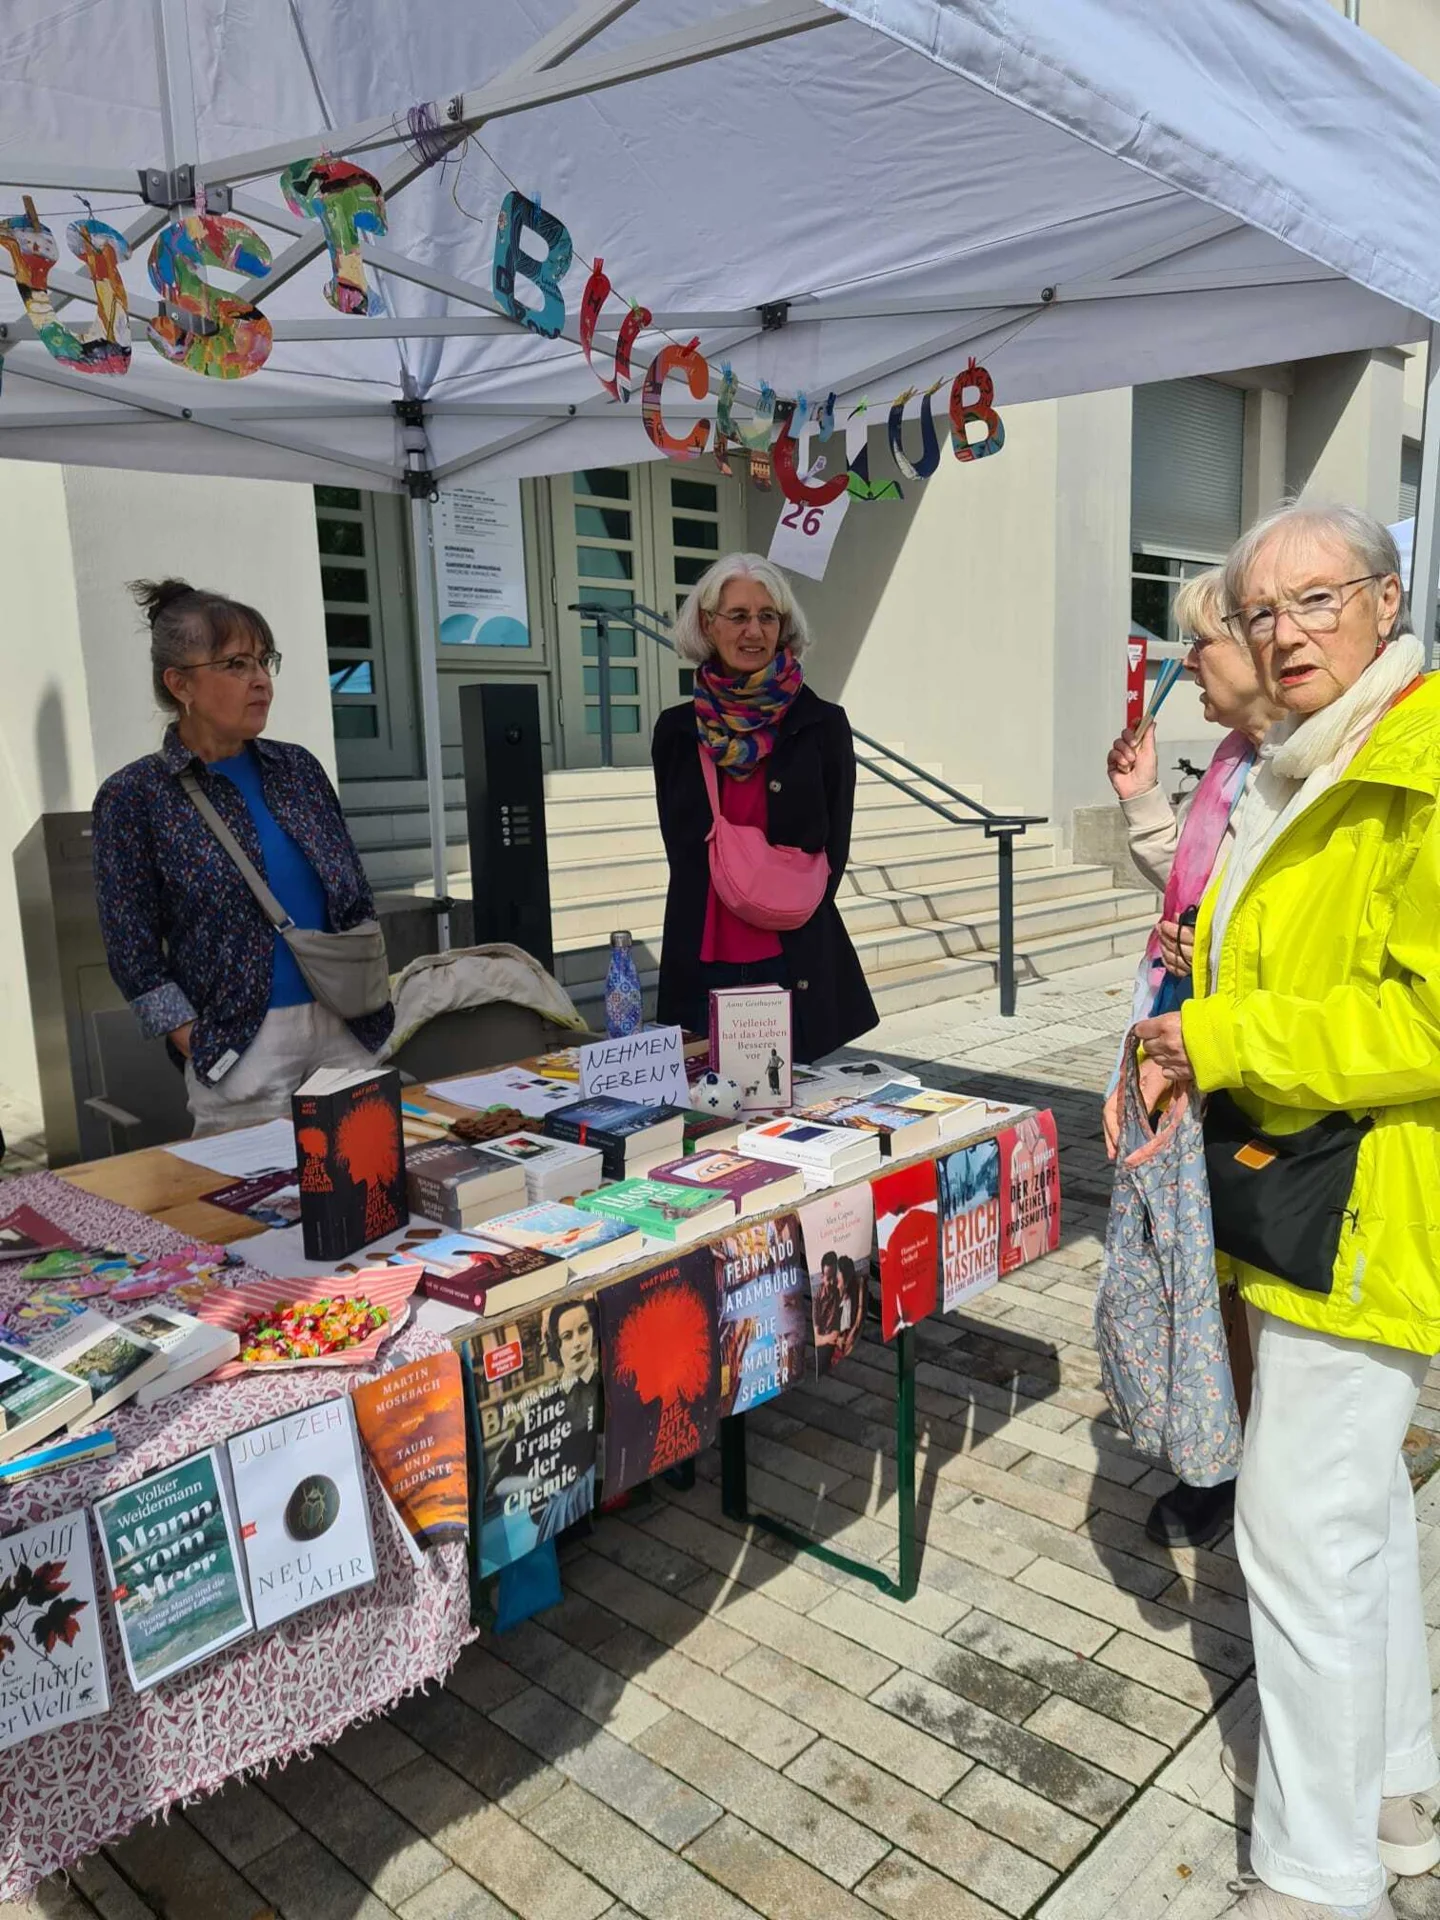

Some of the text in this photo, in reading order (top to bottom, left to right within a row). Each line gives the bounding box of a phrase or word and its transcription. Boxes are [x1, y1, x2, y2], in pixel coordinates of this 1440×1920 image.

[781, 500, 824, 536] 26
[722, 1029, 787, 1040] hat das Leben
[732, 1018, 777, 1028] Vielleicht
[586, 1033, 677, 1071] NEHMEN
[738, 1042, 777, 1050] Besseres
[590, 1064, 665, 1095] GEBEN
[302, 1173, 331, 1187] ZORA
[1010, 1166, 1056, 1202] DER ZOPF
[366, 1203, 396, 1228] ZORA
[1018, 1191, 1047, 1214] MEINER
[944, 1197, 997, 1259] ERICH
[726, 1239, 794, 1283] FERNANDO
[725, 1267, 798, 1314] ARAMBURU
[755, 1316, 777, 1341] DIE
[744, 1341, 789, 1374] MAUER
[375, 1378, 441, 1414] MOSEBACH
[382, 1367, 429, 1395] MARTIN
[741, 1367, 790, 1403] SEGLER
[502, 1393, 540, 1419] Bonnie
[524, 1400, 566, 1435] Eine
[237, 1407, 342, 1464] JULI ZEH
[514, 1421, 572, 1465] Frage
[653, 1423, 699, 1462] ZORA
[656, 1408, 691, 1444] ROTE
[396, 1435, 435, 1461] TAUBE
[404, 1454, 431, 1473] UND
[528, 1452, 561, 1481] der
[117, 1480, 203, 1529] Weidermann
[136, 1477, 179, 1505] Volker
[504, 1464, 577, 1517] Chemie
[9, 1521, 78, 1567] Wolff
[116, 1500, 213, 1557] Mann
[131, 1530, 205, 1576] vom
[135, 1552, 217, 1604] Meer
[259, 1552, 313, 1596] NEU
[294, 1556, 366, 1603] JAHR
[137, 1578, 225, 1630] Thomas Mann und die
[168, 1607, 193, 1625] seines
[193, 1590, 222, 1610] Lebens
[21, 1688, 73, 1727] Welt
